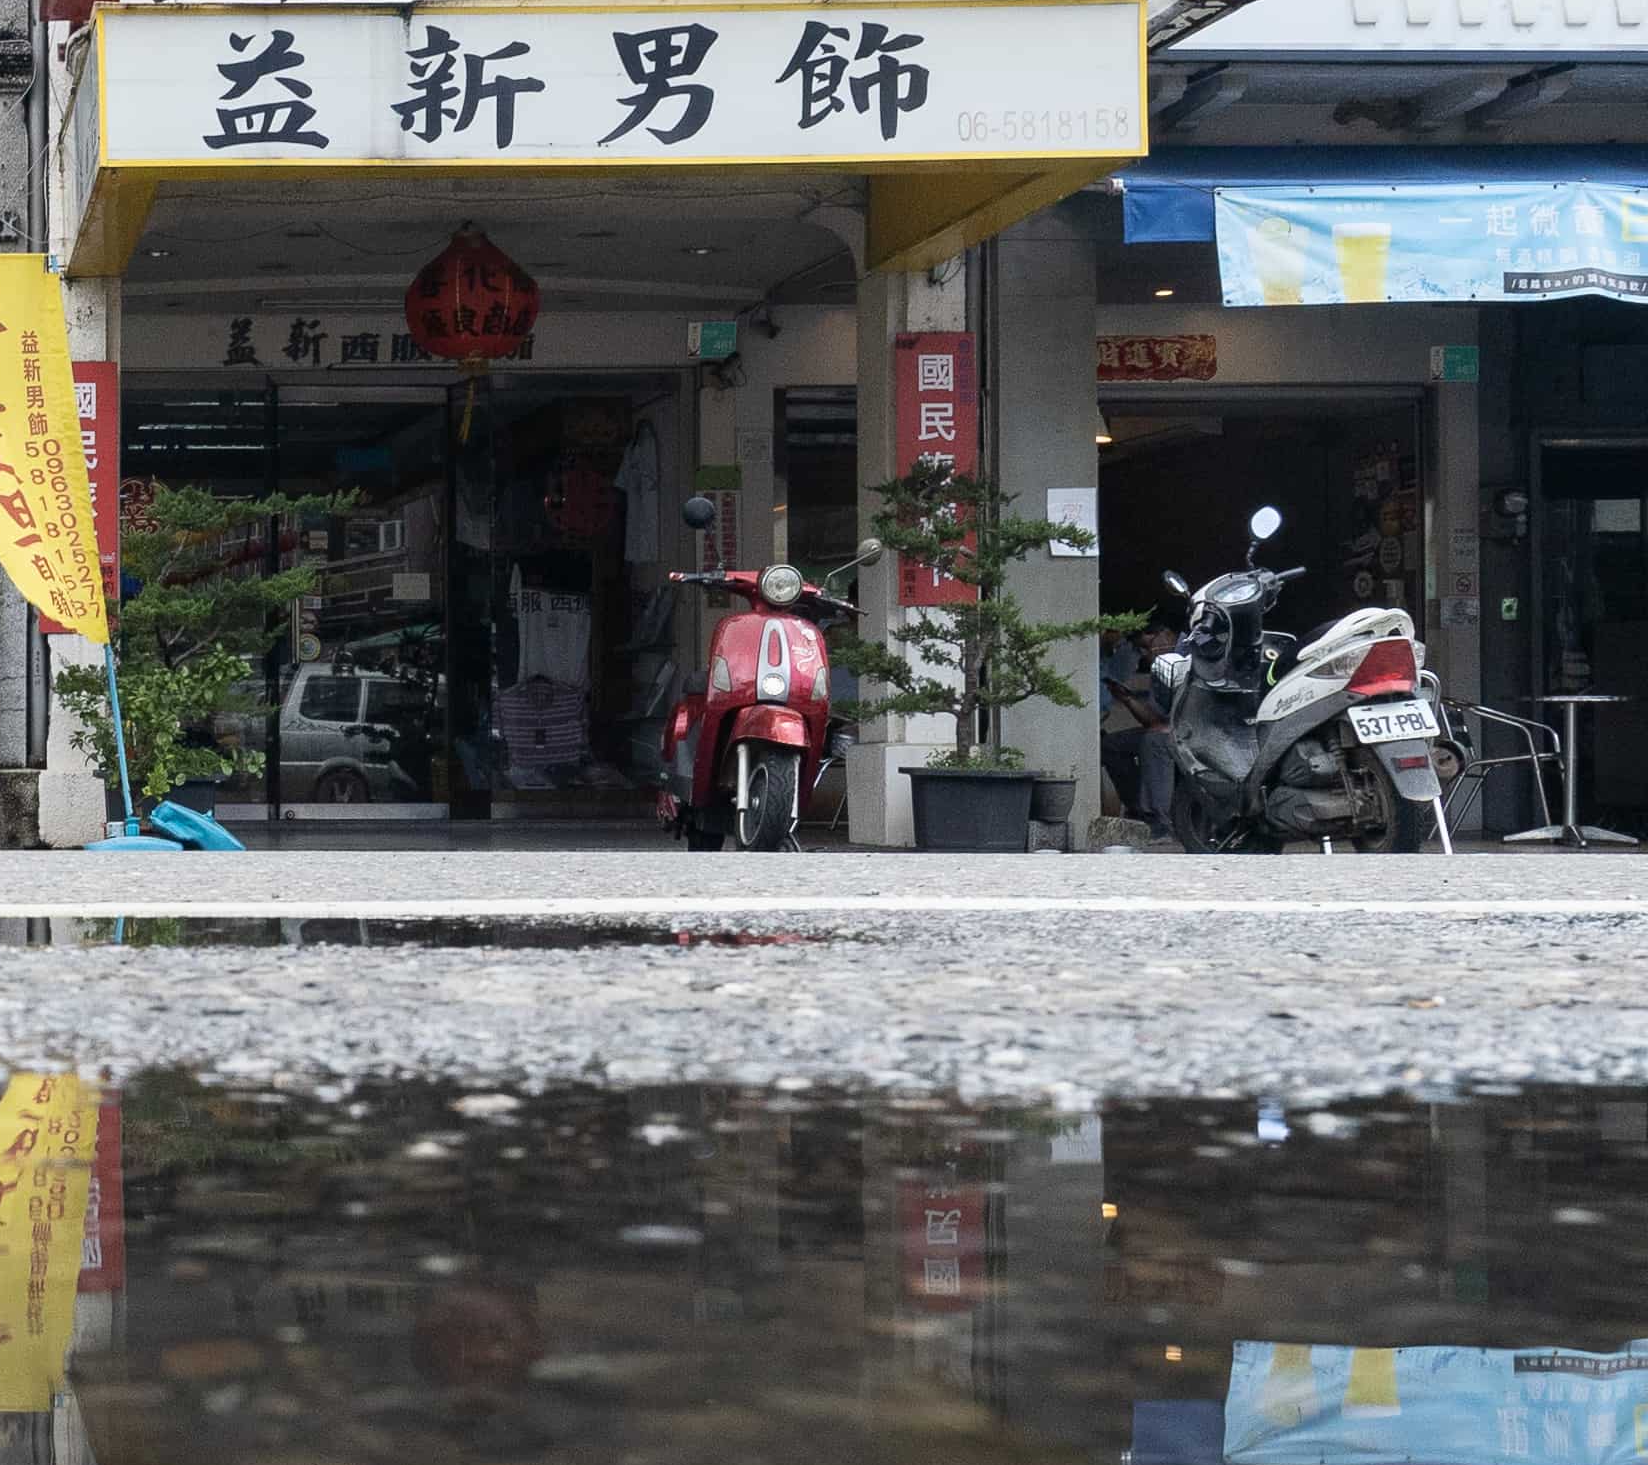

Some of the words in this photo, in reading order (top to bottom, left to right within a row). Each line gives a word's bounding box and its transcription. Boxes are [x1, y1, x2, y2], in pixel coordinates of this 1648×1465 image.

[203, 19, 931, 149] 益新男飾
[957, 106, 1129, 142] 06-5818158
[20, 330, 49, 437] 益新男飾
[1356, 711, 1435, 738] 537-PBL
